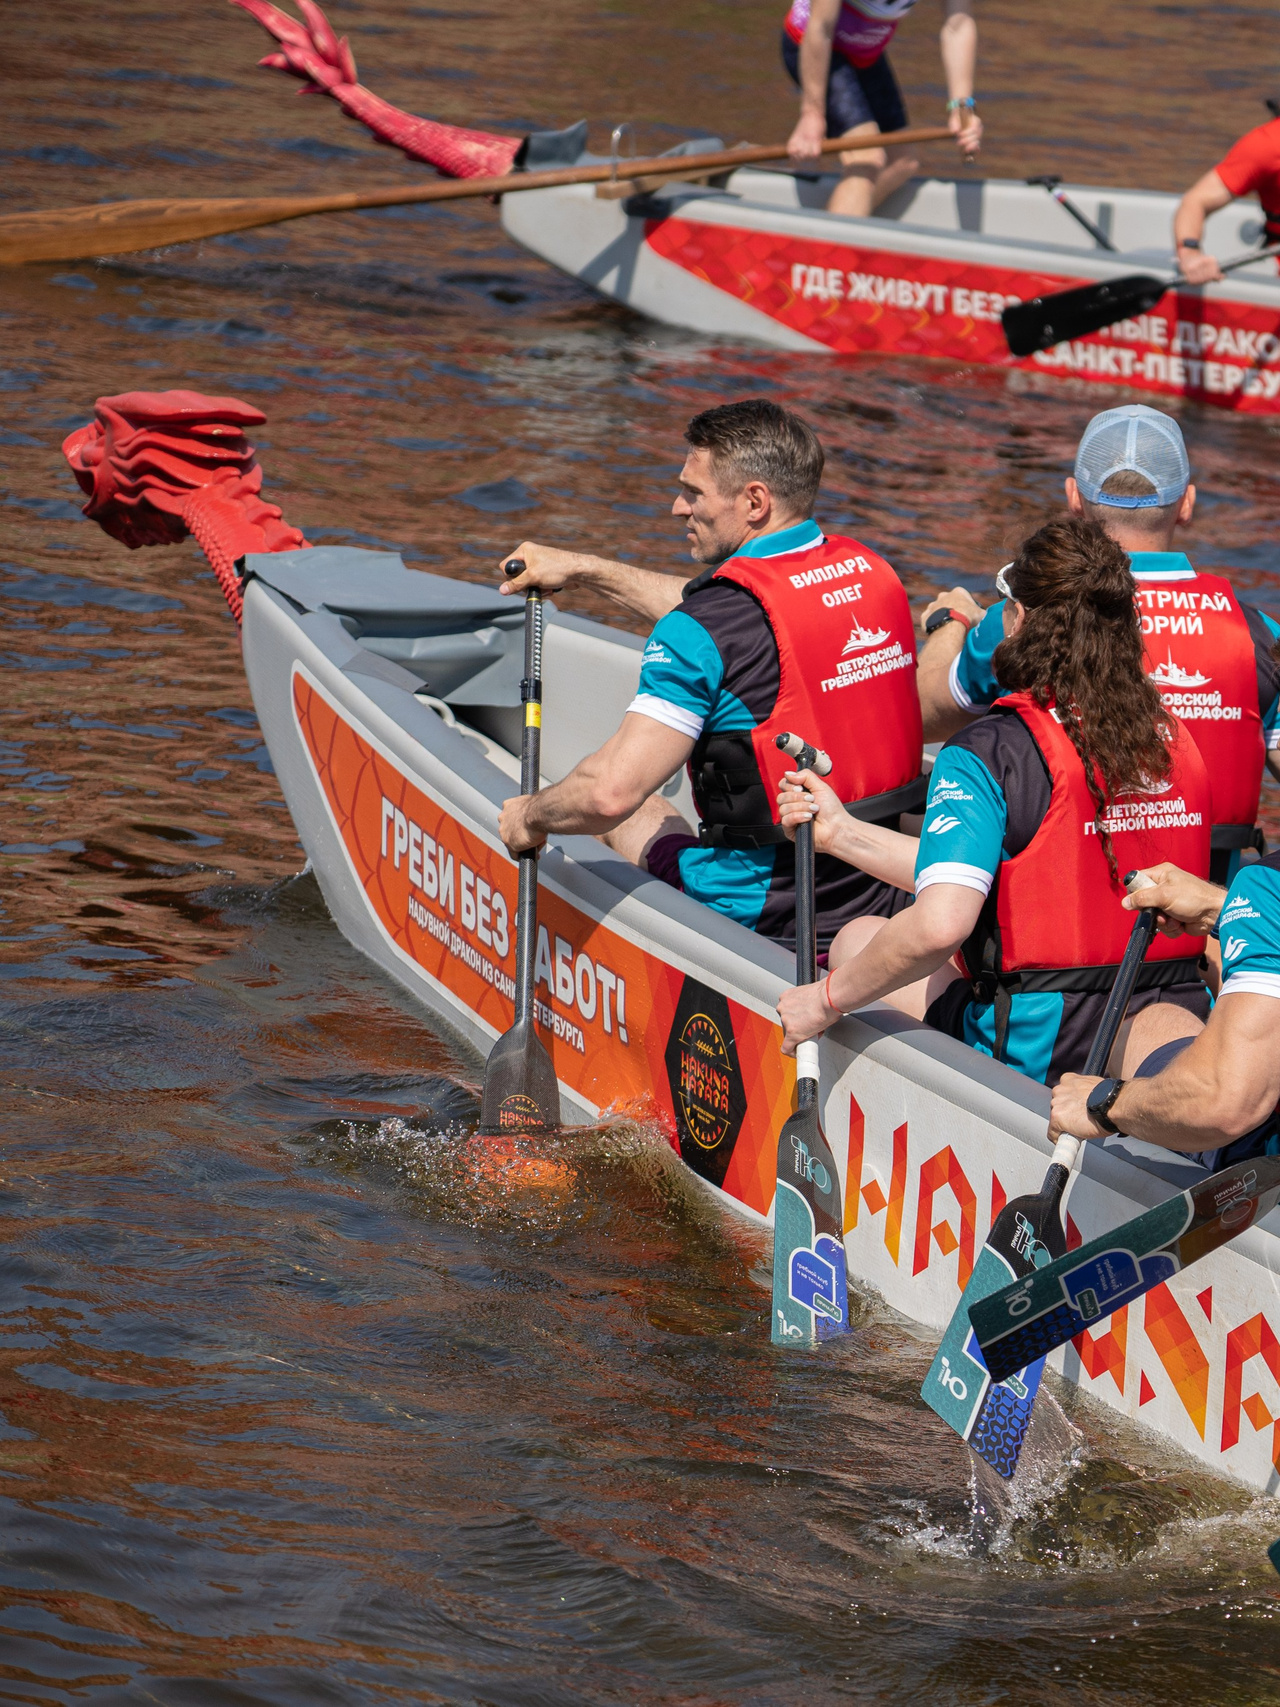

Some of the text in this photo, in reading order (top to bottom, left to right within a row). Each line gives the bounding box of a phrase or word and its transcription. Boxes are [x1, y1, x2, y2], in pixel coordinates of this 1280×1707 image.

[791, 262, 844, 303] ГДЕ
[847, 271, 949, 315] ЖИВУТ
[788, 555, 872, 590] ВИЛЛАРД
[821, 583, 863, 608] ОЛЕГ
[820, 652, 913, 693] ГРЕБНОЙ МАРАФОН
[836, 641, 903, 675] ПЕТРОВСКИЙ
[1160, 690, 1222, 706] ОВСКИЙ
[1106, 797, 1187, 819] ПЕТРОВСКИЙ
[1147, 812, 1203, 830] МАРАФОН
[381, 795, 628, 1045] ГРЕБИ БЕЗ АБОТ!
[408, 895, 451, 947] НАДУВНОЙ
[450, 930, 482, 974] ДРАКОН
[482, 957, 494, 983] ИЗ
